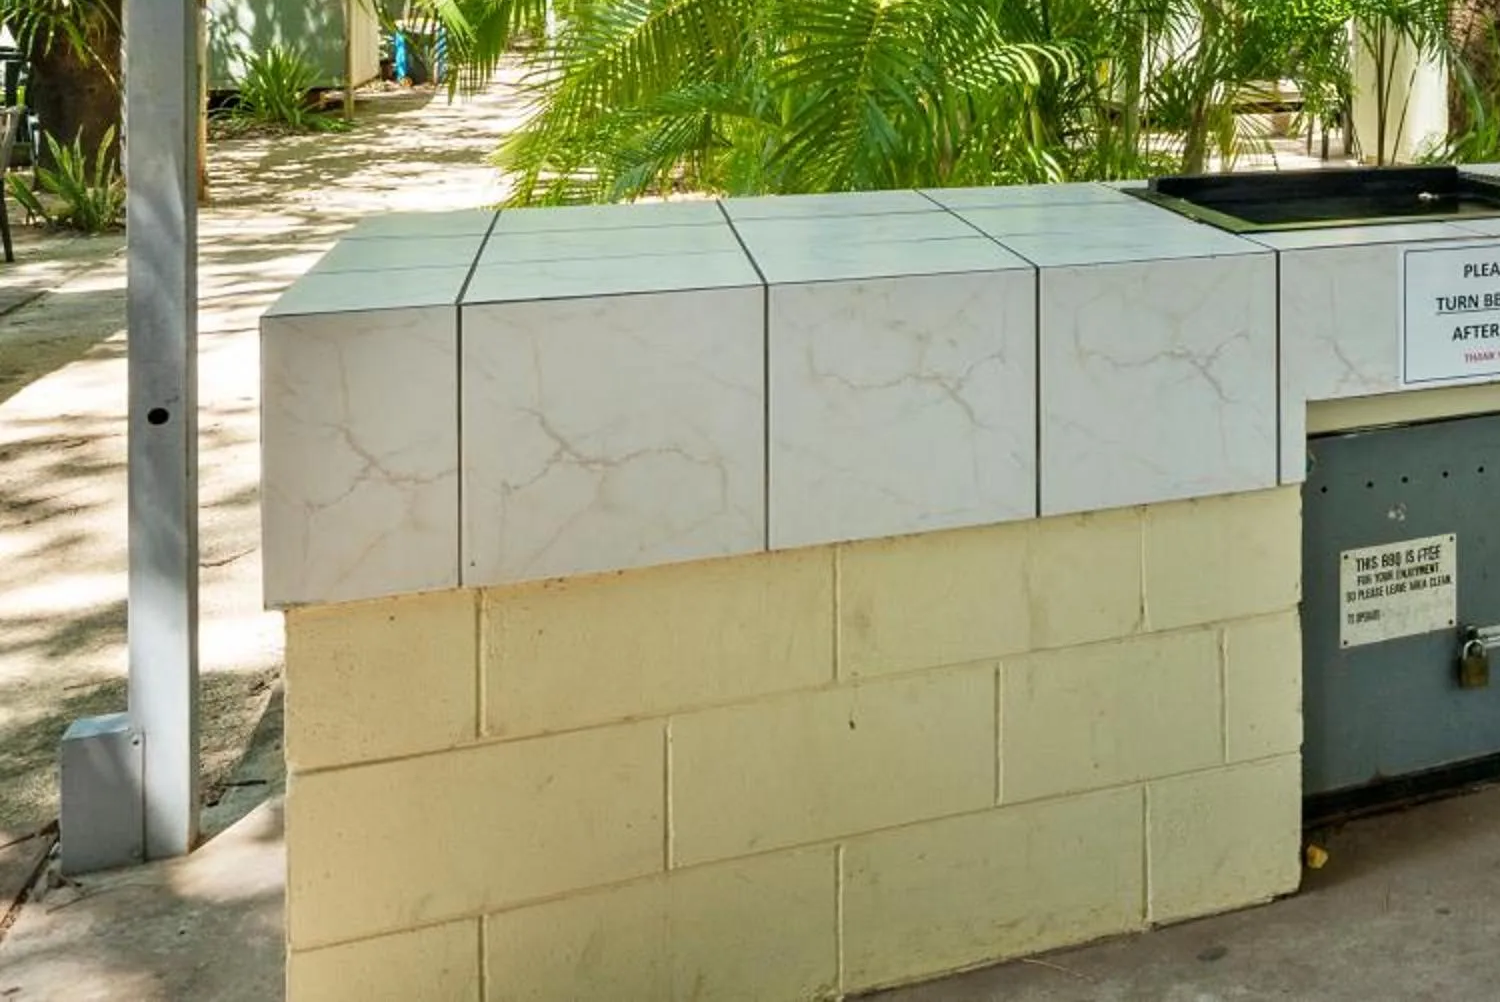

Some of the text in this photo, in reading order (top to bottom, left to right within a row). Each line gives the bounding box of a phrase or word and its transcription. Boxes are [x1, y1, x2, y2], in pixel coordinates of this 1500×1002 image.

[1436, 294, 1479, 311] TURN
[1452, 322, 1499, 341] AFTER
[1464, 351, 1495, 363] THANK
[1356, 555, 1378, 572] THIS
[1405, 549, 1415, 564] IS
[1358, 586, 1383, 601] PLEASE
